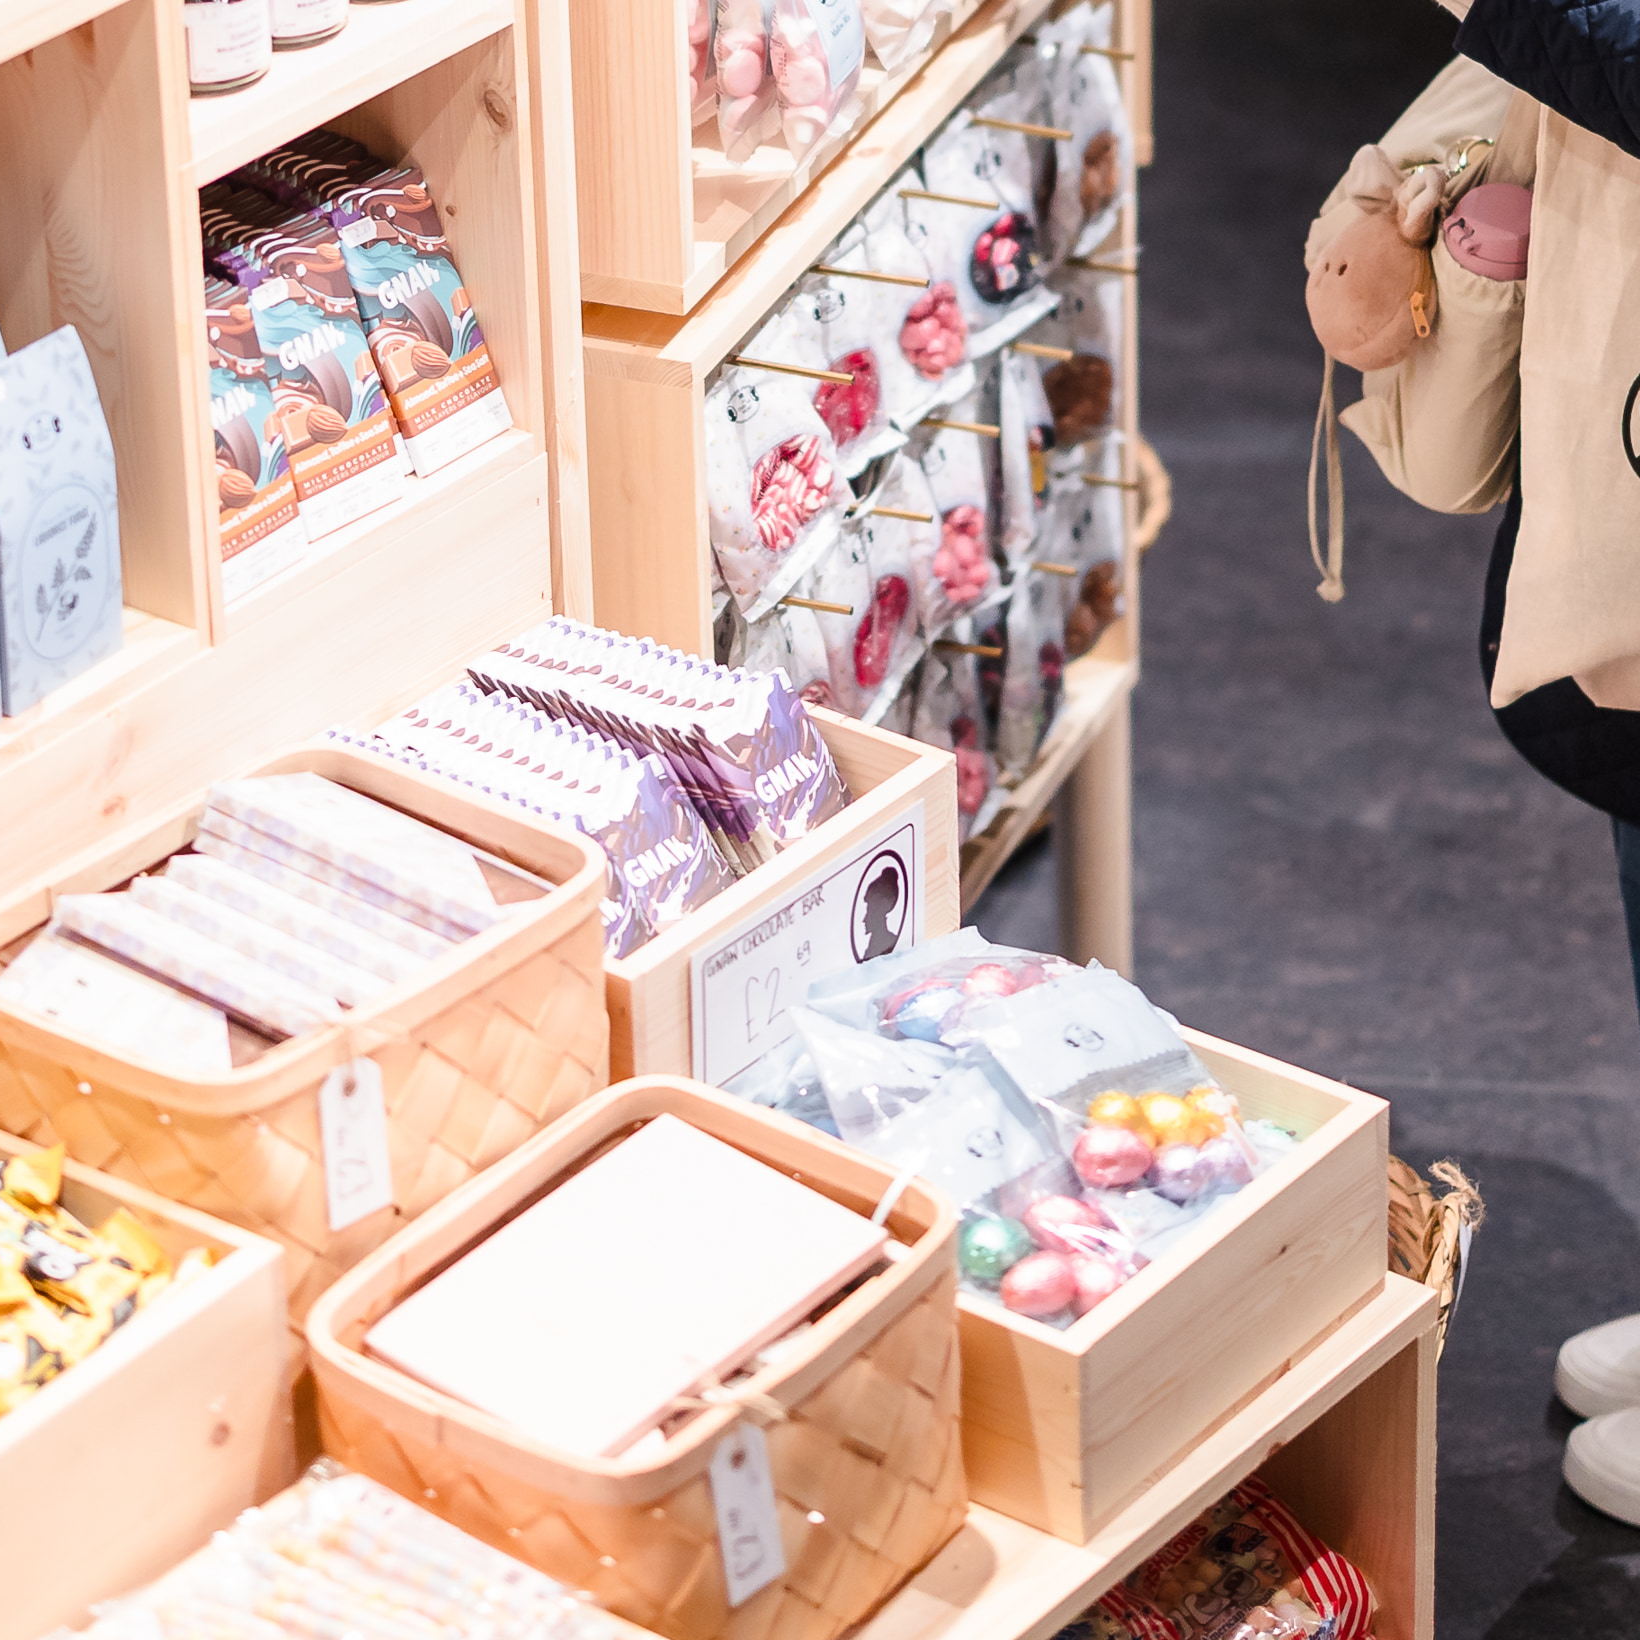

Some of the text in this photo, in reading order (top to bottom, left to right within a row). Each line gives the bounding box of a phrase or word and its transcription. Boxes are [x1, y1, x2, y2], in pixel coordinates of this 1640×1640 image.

[378, 260, 440, 309] GNAW
[279, 321, 346, 371] GNAW
[463, 361, 477, 376] Sea
[476, 353, 489, 367] Salt
[414, 375, 491, 425] MILK CHOCOLATE
[417, 382, 493, 431] WITH LAYERS OF FLAVOUR
[303, 442, 389, 489] MILK CHOCOLATE
[361, 450, 390, 471] FLAVOUR
[755, 751, 820, 804] GNAW
[623, 835, 696, 887] GNAW
[742, 903, 795, 956] CHOCOLATE
[801, 883, 826, 917] BAR
